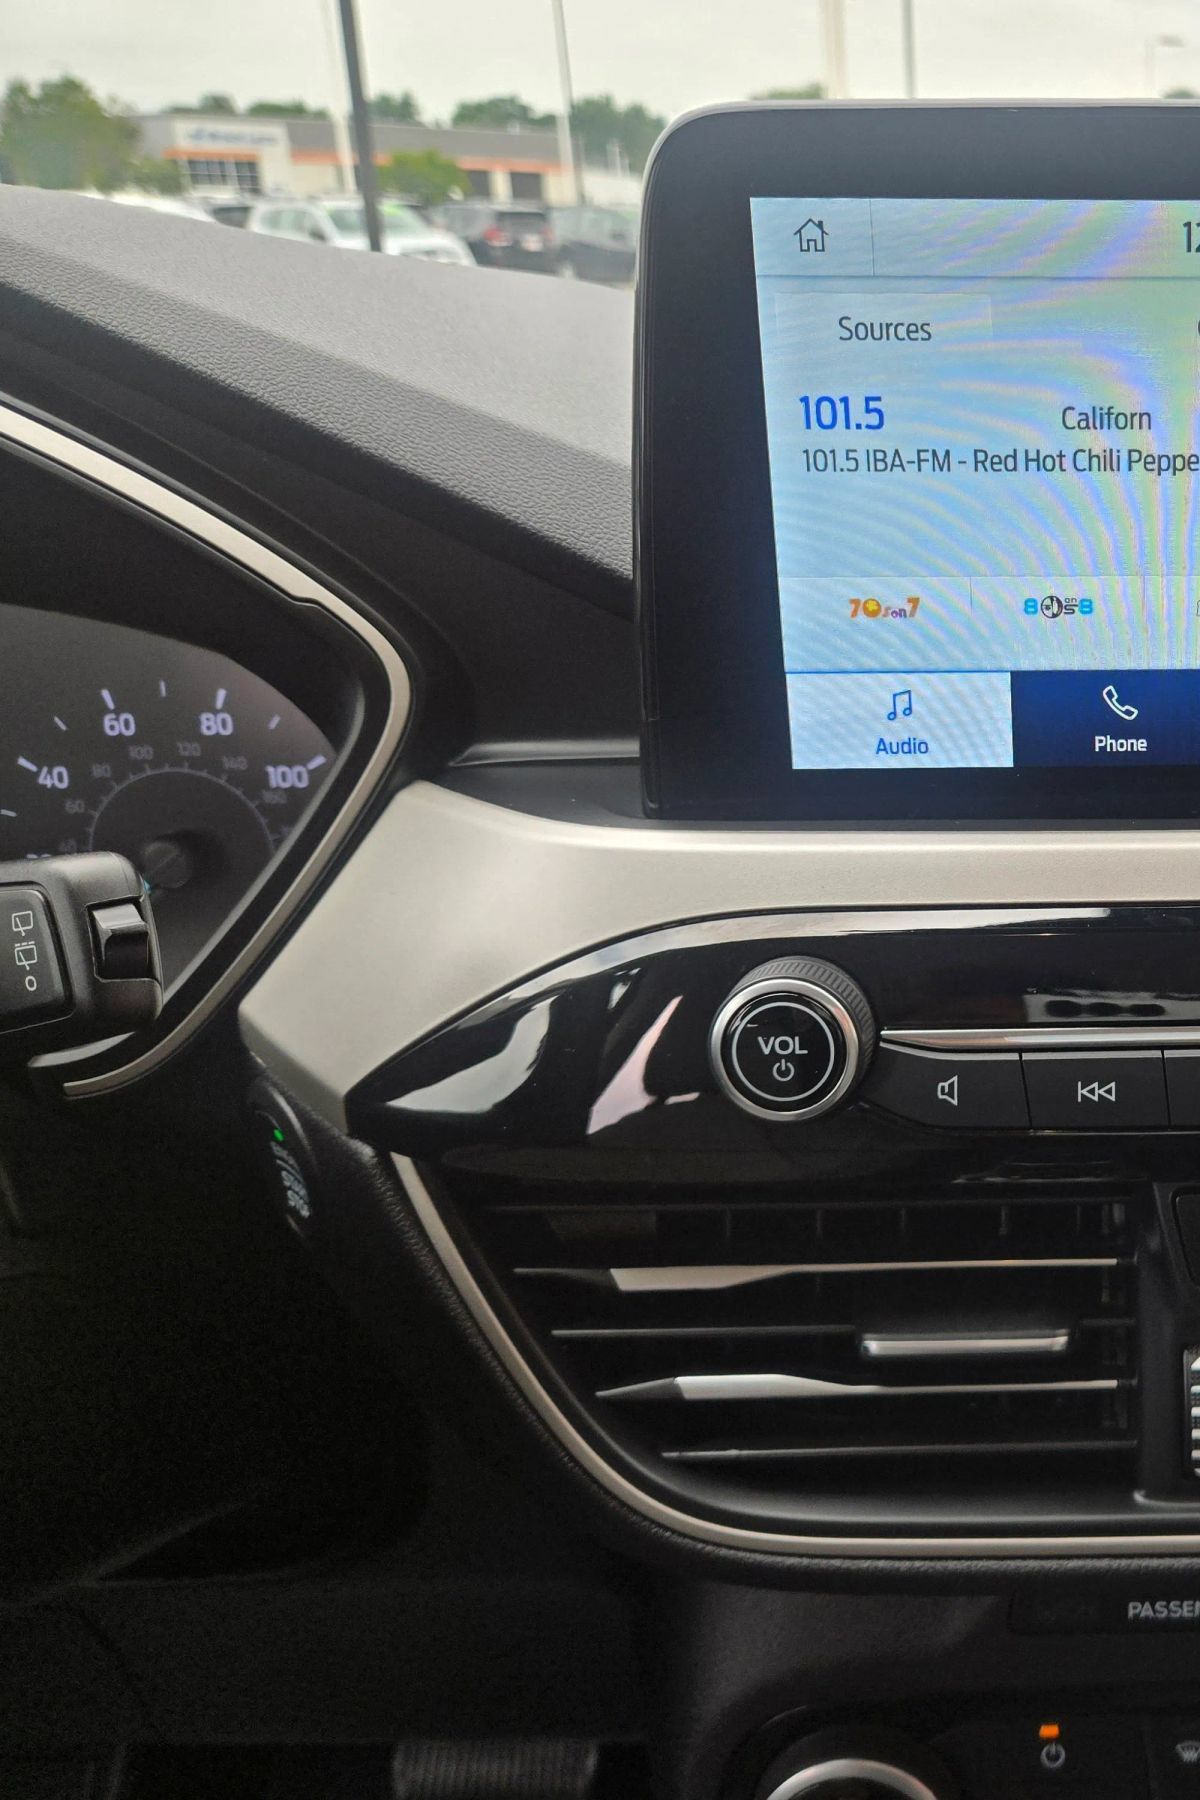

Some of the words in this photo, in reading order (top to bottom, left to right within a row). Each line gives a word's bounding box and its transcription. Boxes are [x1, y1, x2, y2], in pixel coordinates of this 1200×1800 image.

[838, 316, 932, 341] Sources
[799, 395, 885, 430] 101.5
[1062, 406, 1152, 430] Californ
[802, 448, 859, 473] 101.5
[866, 448, 951, 473] IBA-FM
[973, 448, 1018, 473] Red
[1024, 448, 1066, 472] Hot
[1073, 447, 1121, 472] Chili
[103, 713, 136, 736] 60
[200, 713, 233, 736] 80
[876, 737, 929, 754] Audio
[1094, 735, 1148, 753] Phone
[37, 766, 69, 789] 40
[265, 765, 309, 788] 100
[757, 1035, 808, 1056] VOL
